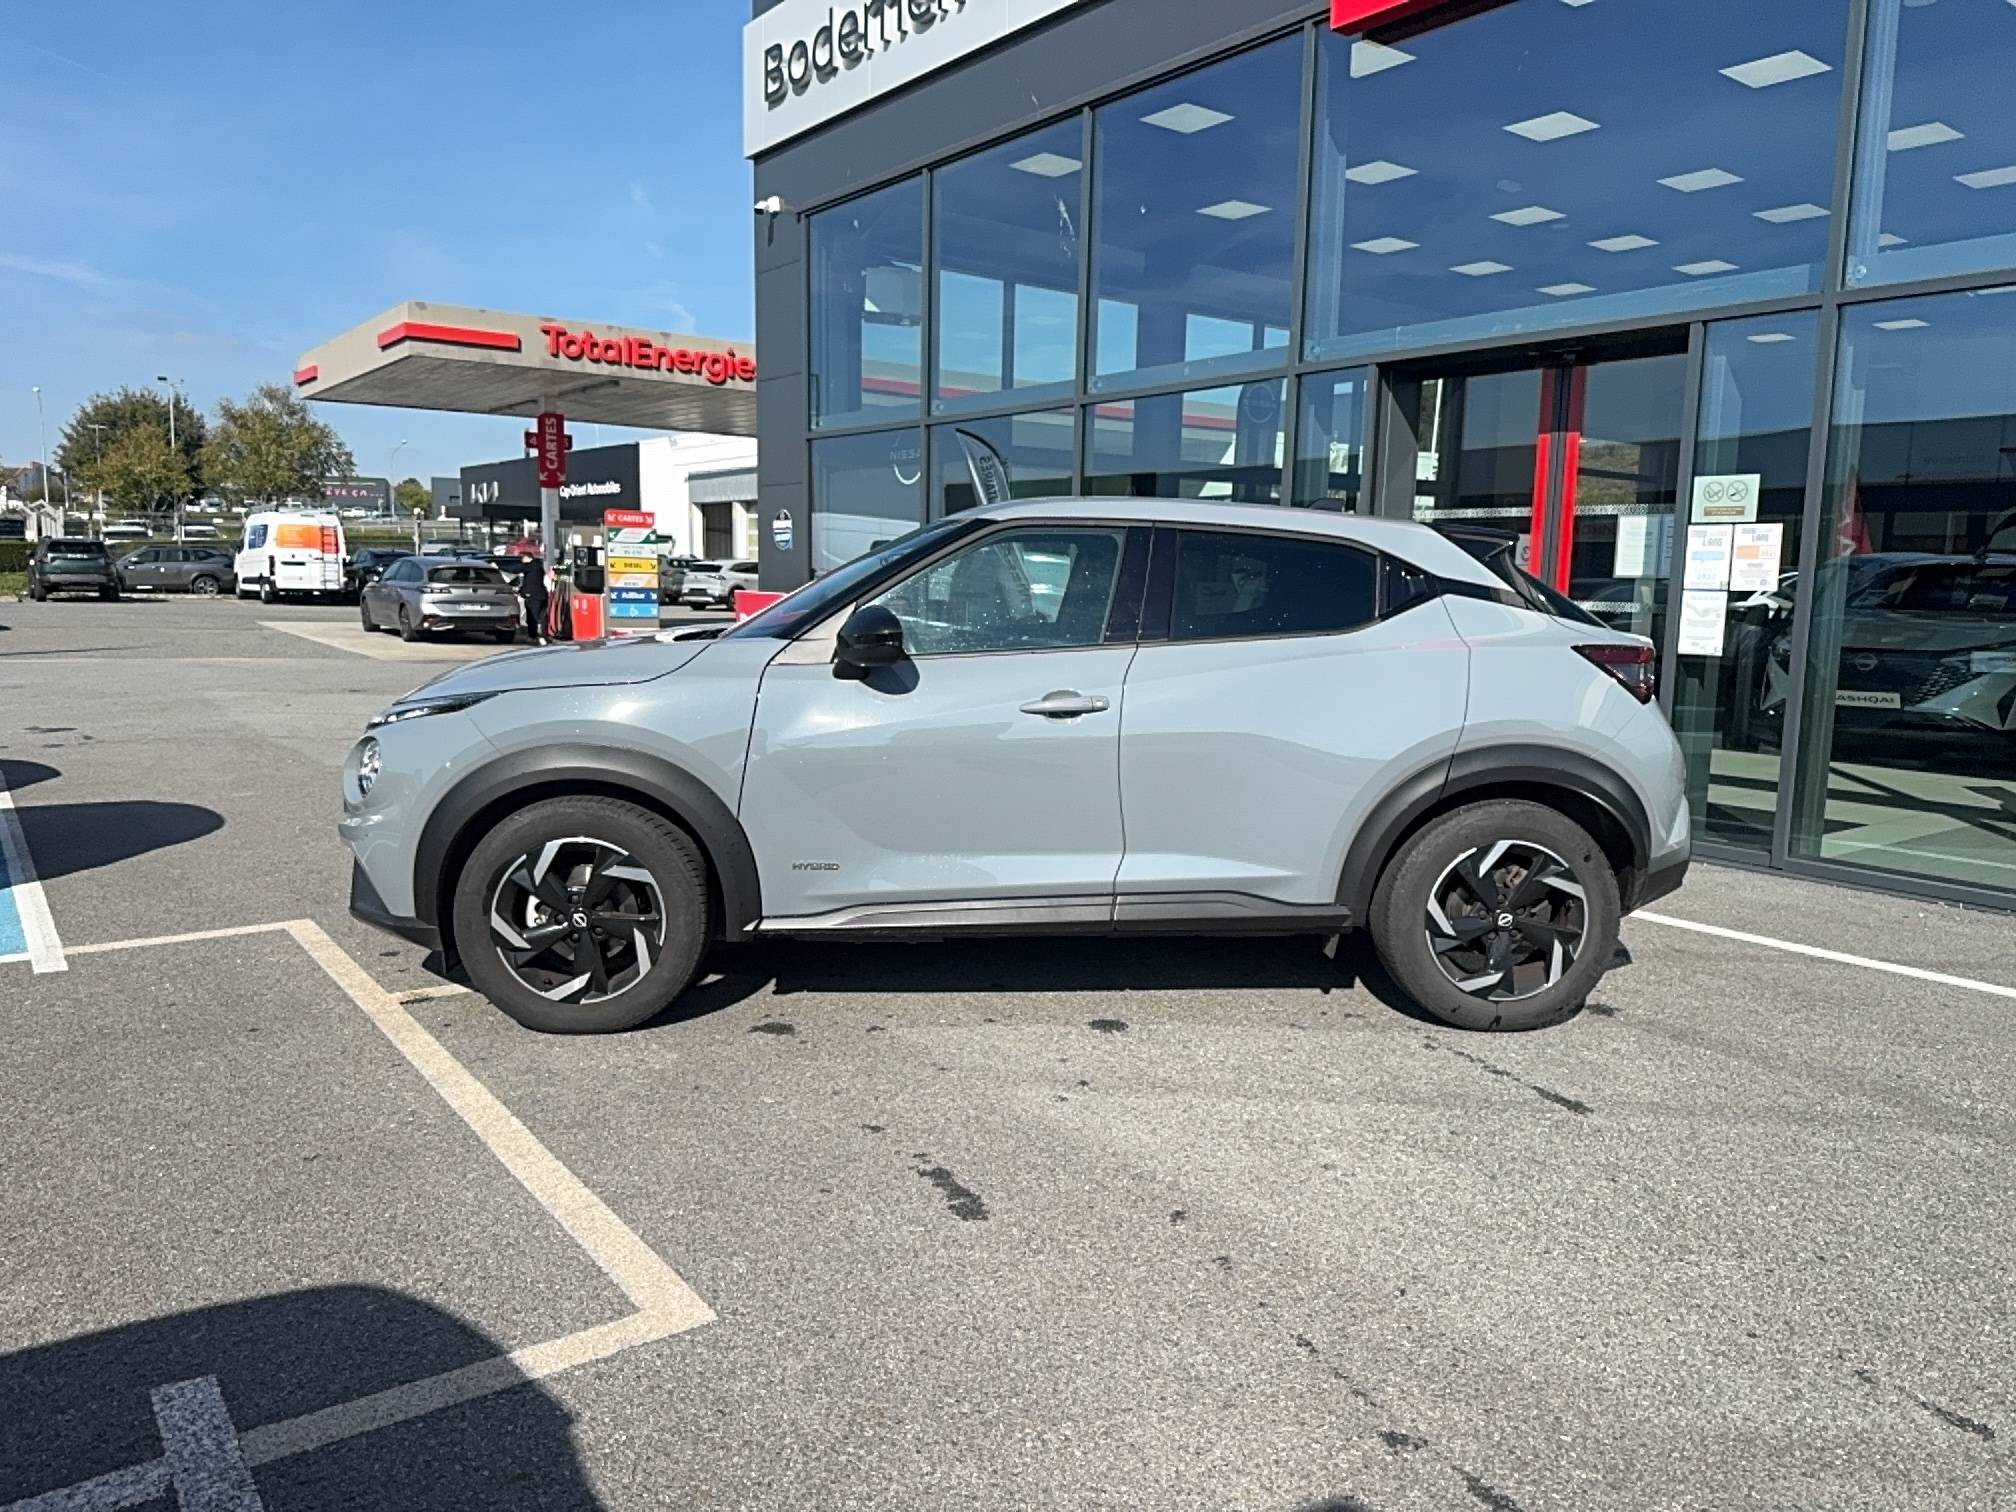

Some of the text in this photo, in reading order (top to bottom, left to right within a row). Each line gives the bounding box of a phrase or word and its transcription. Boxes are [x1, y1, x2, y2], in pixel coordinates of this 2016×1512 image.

[540, 322, 757, 384] TotalEnergie
[545, 417, 559, 470] CARTES
[1836, 693, 1895, 705] ASHQAI
[792, 862, 840, 871] HYBRID
